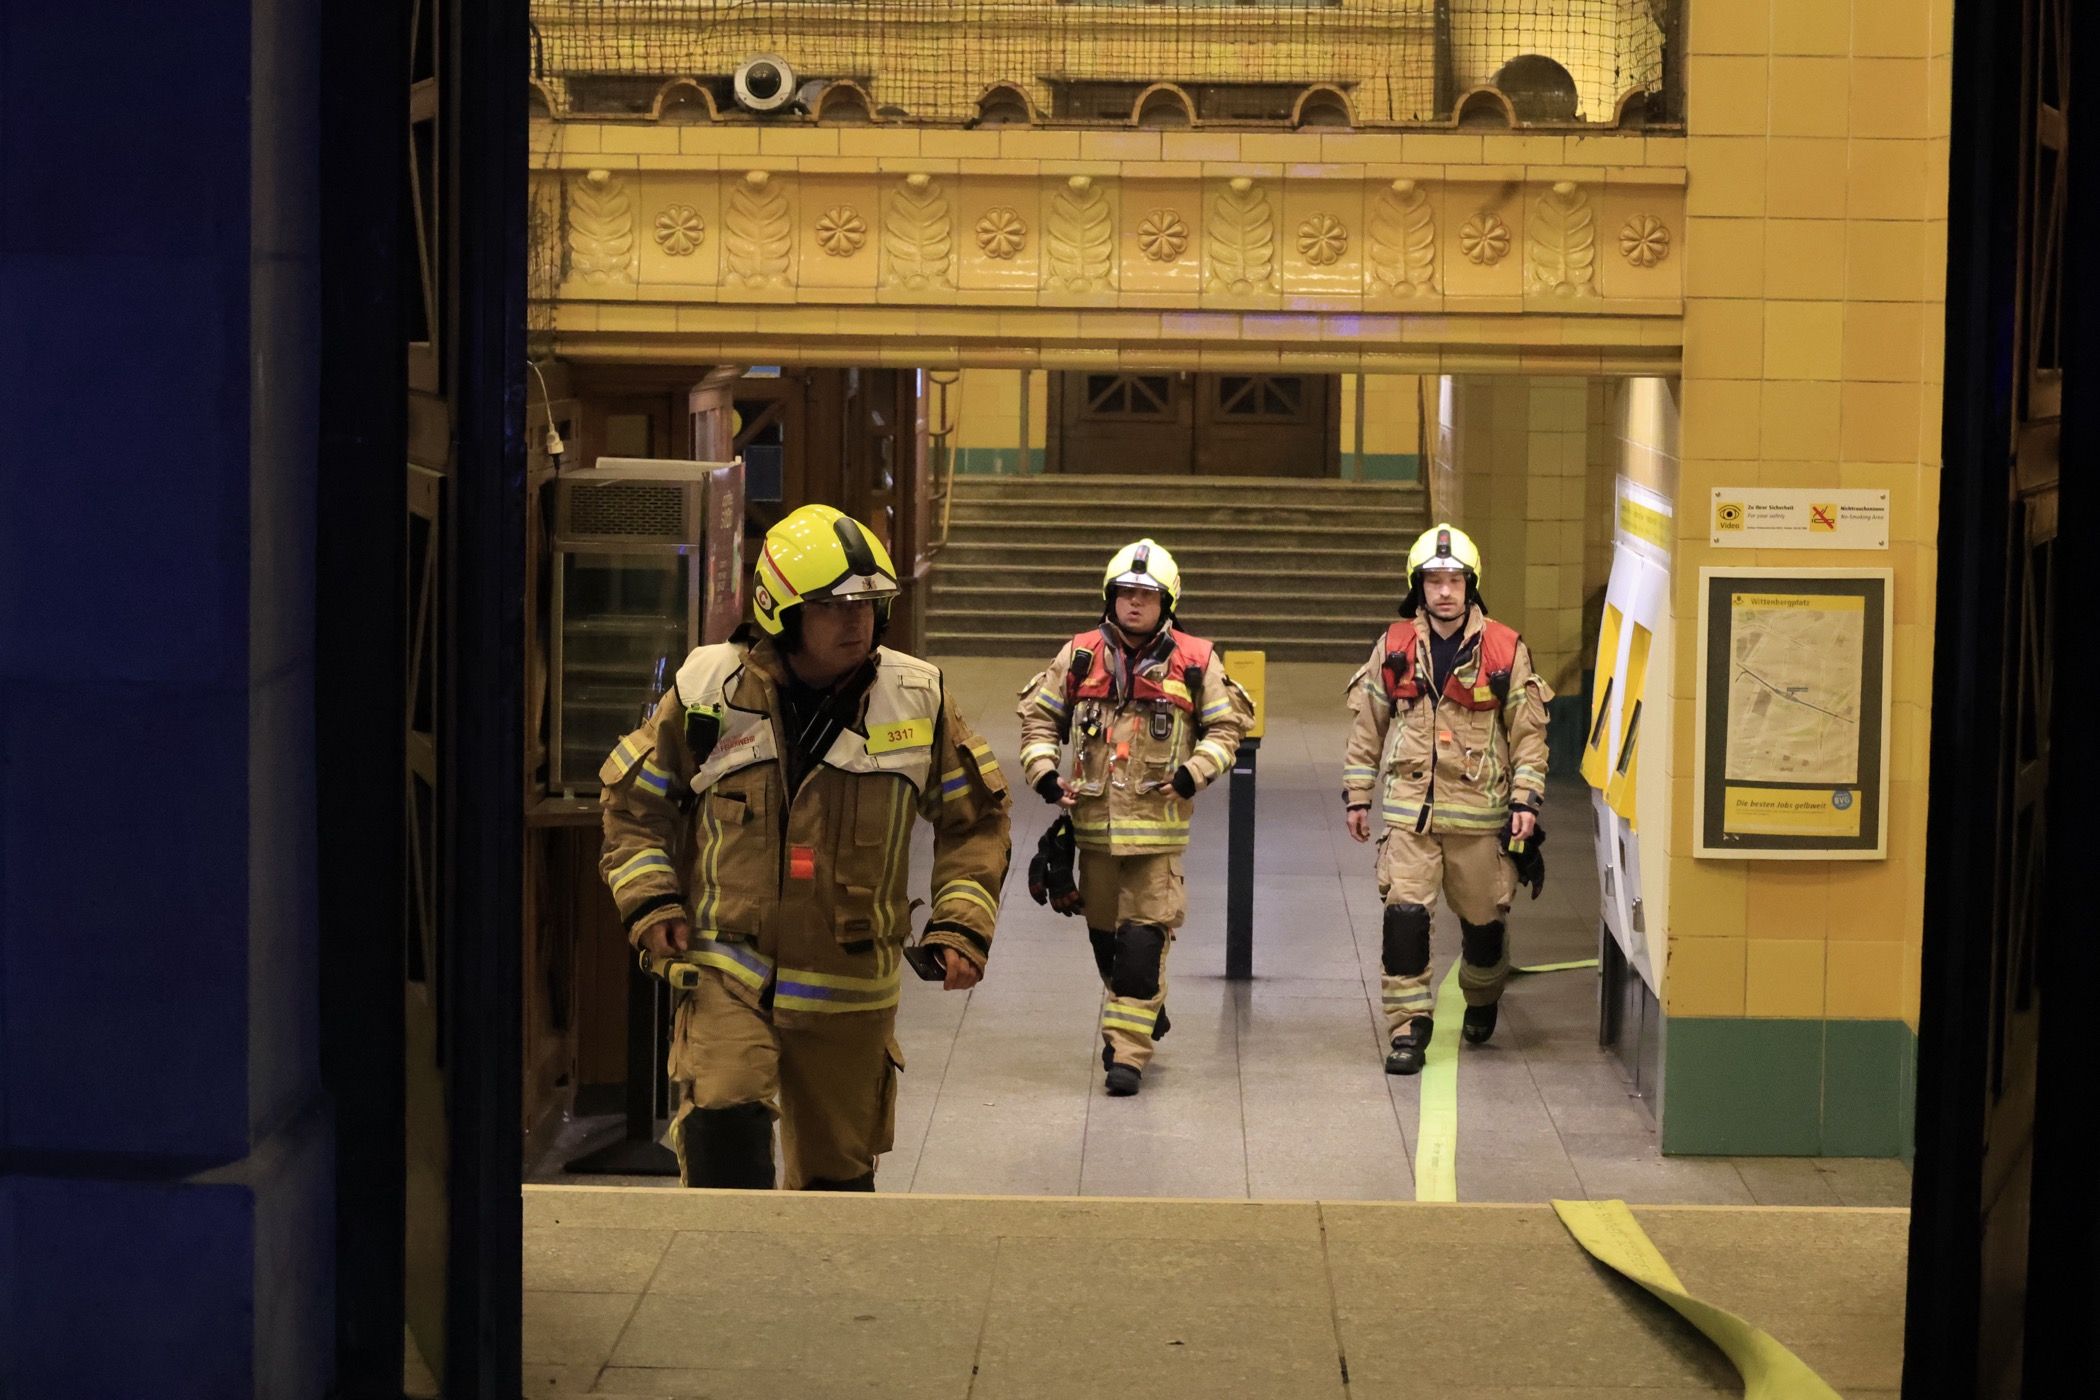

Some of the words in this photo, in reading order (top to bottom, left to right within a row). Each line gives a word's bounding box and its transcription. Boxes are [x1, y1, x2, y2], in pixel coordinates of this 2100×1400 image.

[1751, 597, 1810, 608] Wittenbergplatz
[887, 728, 914, 743] 3317
[1736, 799, 1748, 807] Die
[1750, 799, 1775, 808] besten
[1777, 801, 1793, 809] Jobs
